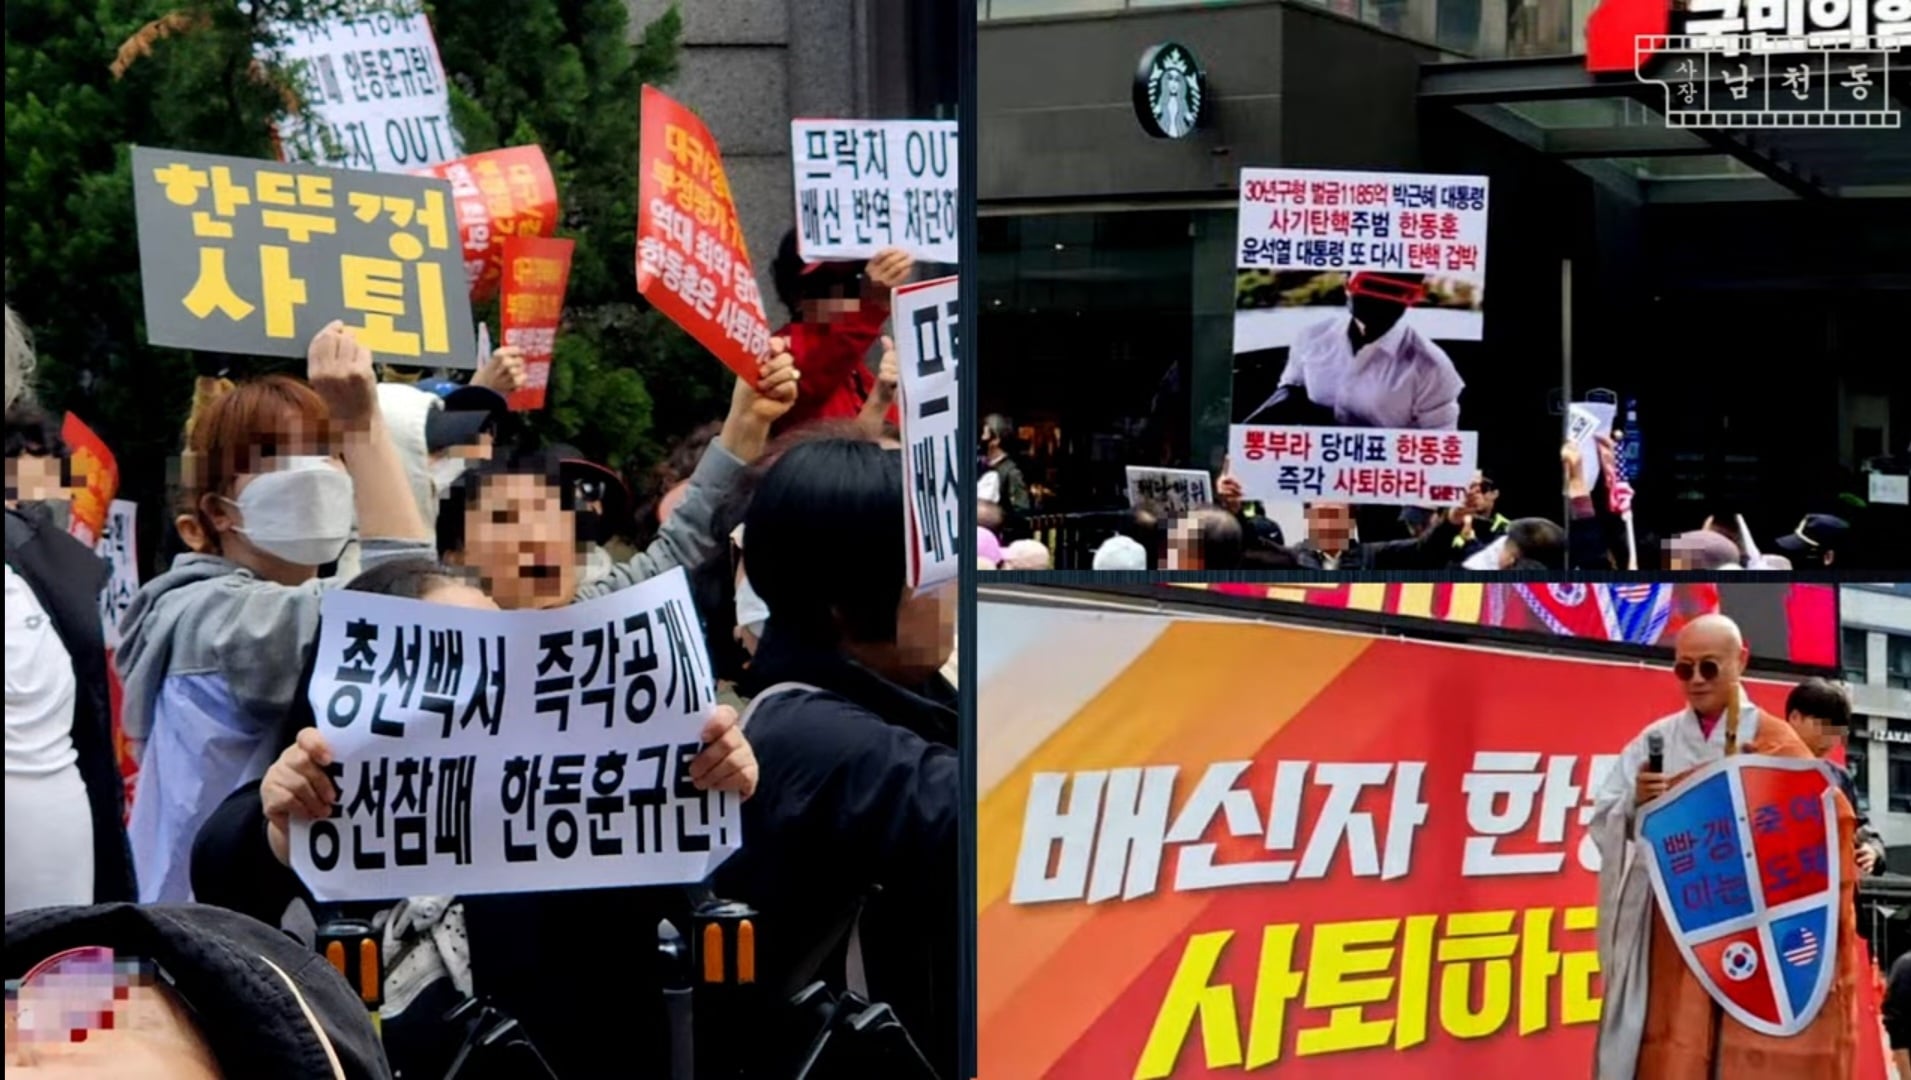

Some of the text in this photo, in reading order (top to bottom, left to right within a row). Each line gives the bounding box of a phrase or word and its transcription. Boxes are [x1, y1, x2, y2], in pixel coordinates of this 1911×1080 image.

[385, 115, 446, 166] OUT
[806, 129, 888, 180] 프락치
[154, 163, 449, 260] 한뚜껑
[852, 187, 892, 245] 반역
[1269, 208, 1459, 240] 사기탄핵주범 한동훈
[1393, 184, 1436, 209] 박근혜
[1441, 185, 1484, 211] 대통령
[650, 197, 692, 257] 역대
[638, 235, 718, 322] 한동훈은
[1242, 237, 1478, 272] 윤석열 대통령 또 다시 탄핵 겁박
[1321, 433, 1387, 463] 당대표
[1396, 435, 1463, 466] 한동훈
[1277, 466, 1325, 495] 즉각
[1333, 469, 1426, 499] 사퇴하라
[326, 598, 716, 739] 총선백서 즉각공개!
[500, 741, 727, 863] 한동훈규탄!
[1010, 750, 1602, 905] 배신자 한
